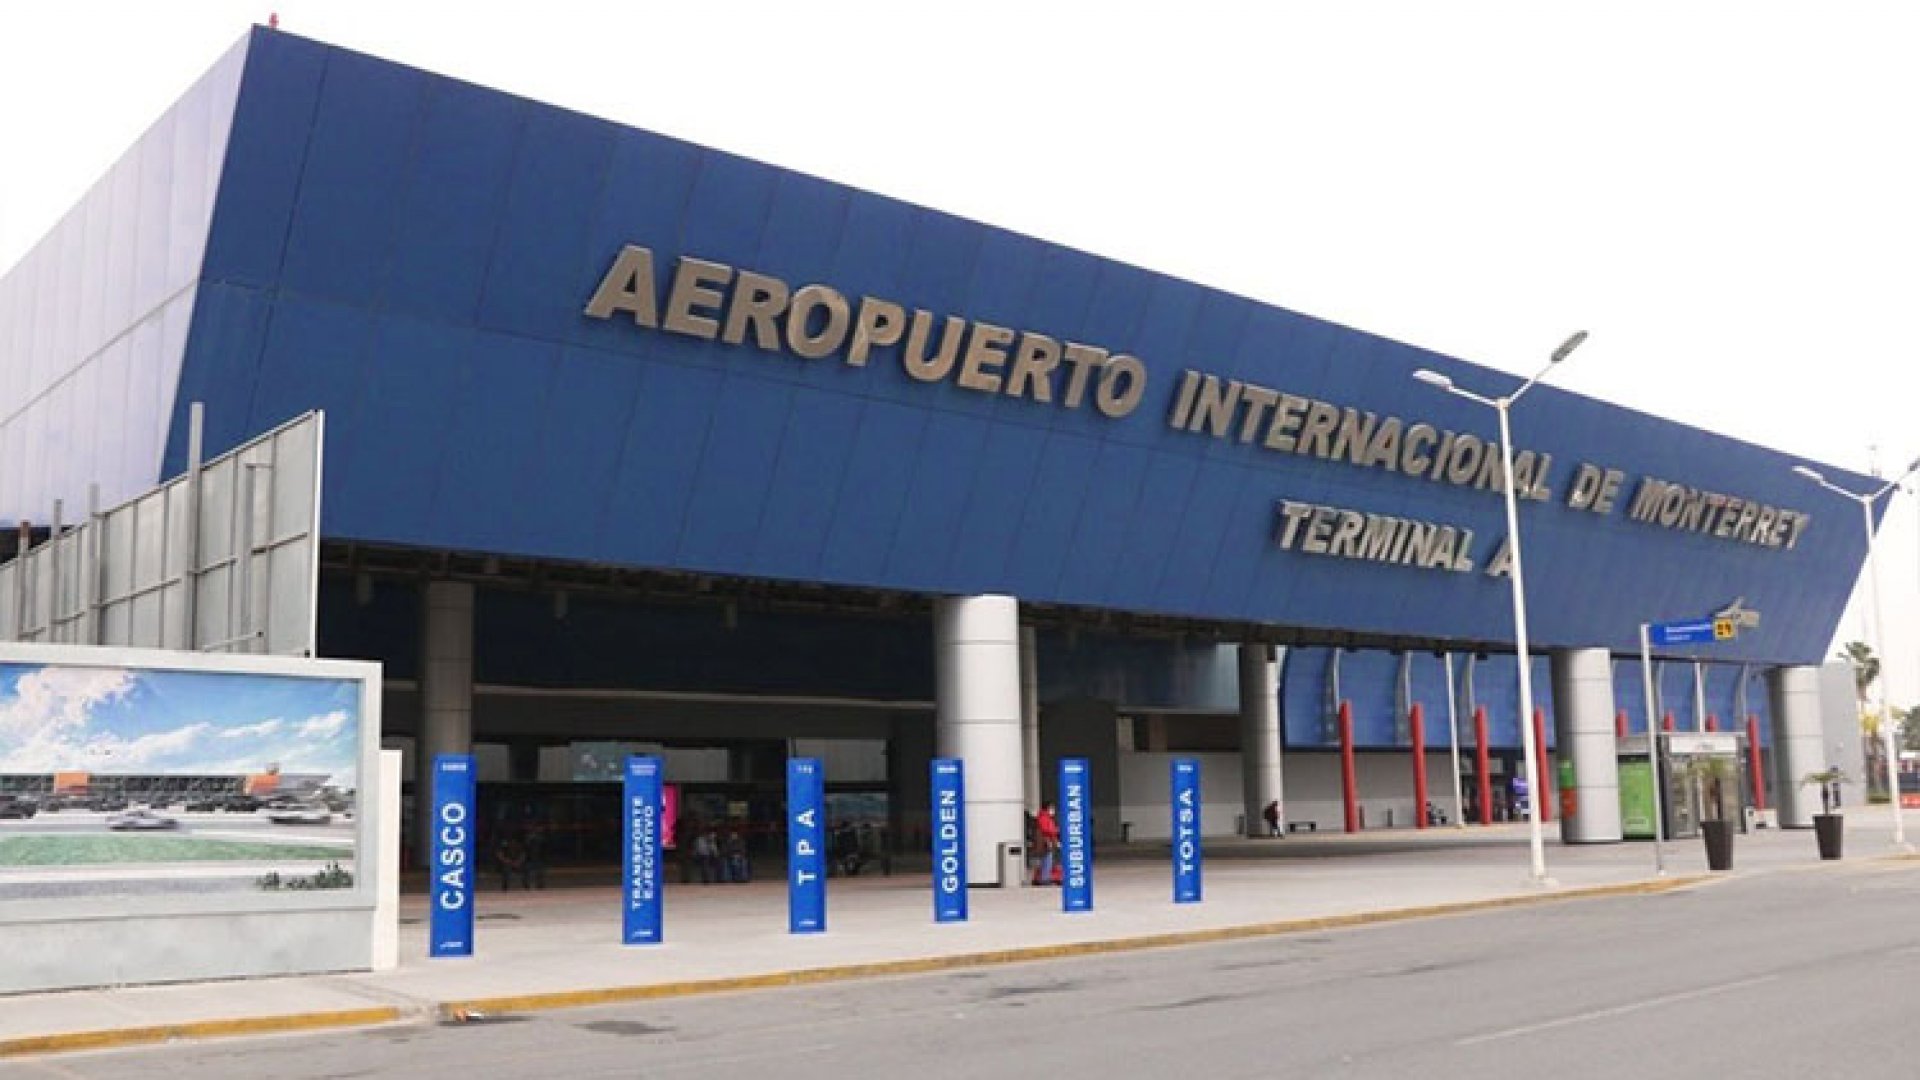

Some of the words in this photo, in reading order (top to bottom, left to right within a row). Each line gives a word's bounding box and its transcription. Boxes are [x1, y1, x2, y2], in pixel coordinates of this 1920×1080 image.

[583, 244, 1148, 418] AEROPUERTO
[1169, 368, 1552, 501] INTERNACIONAL
[1568, 461, 1625, 514] DE
[1629, 475, 1810, 550] MONTERREY
[1278, 498, 1475, 572] TERMINAL
[440, 802, 466, 909] CASCO
[631, 797, 644, 911] TRANSPORTE
[941, 790, 958, 893] GOLDEN
[1068, 785, 1084, 888] SUBURBAN
[1180, 788, 1193, 876] TOTSA
